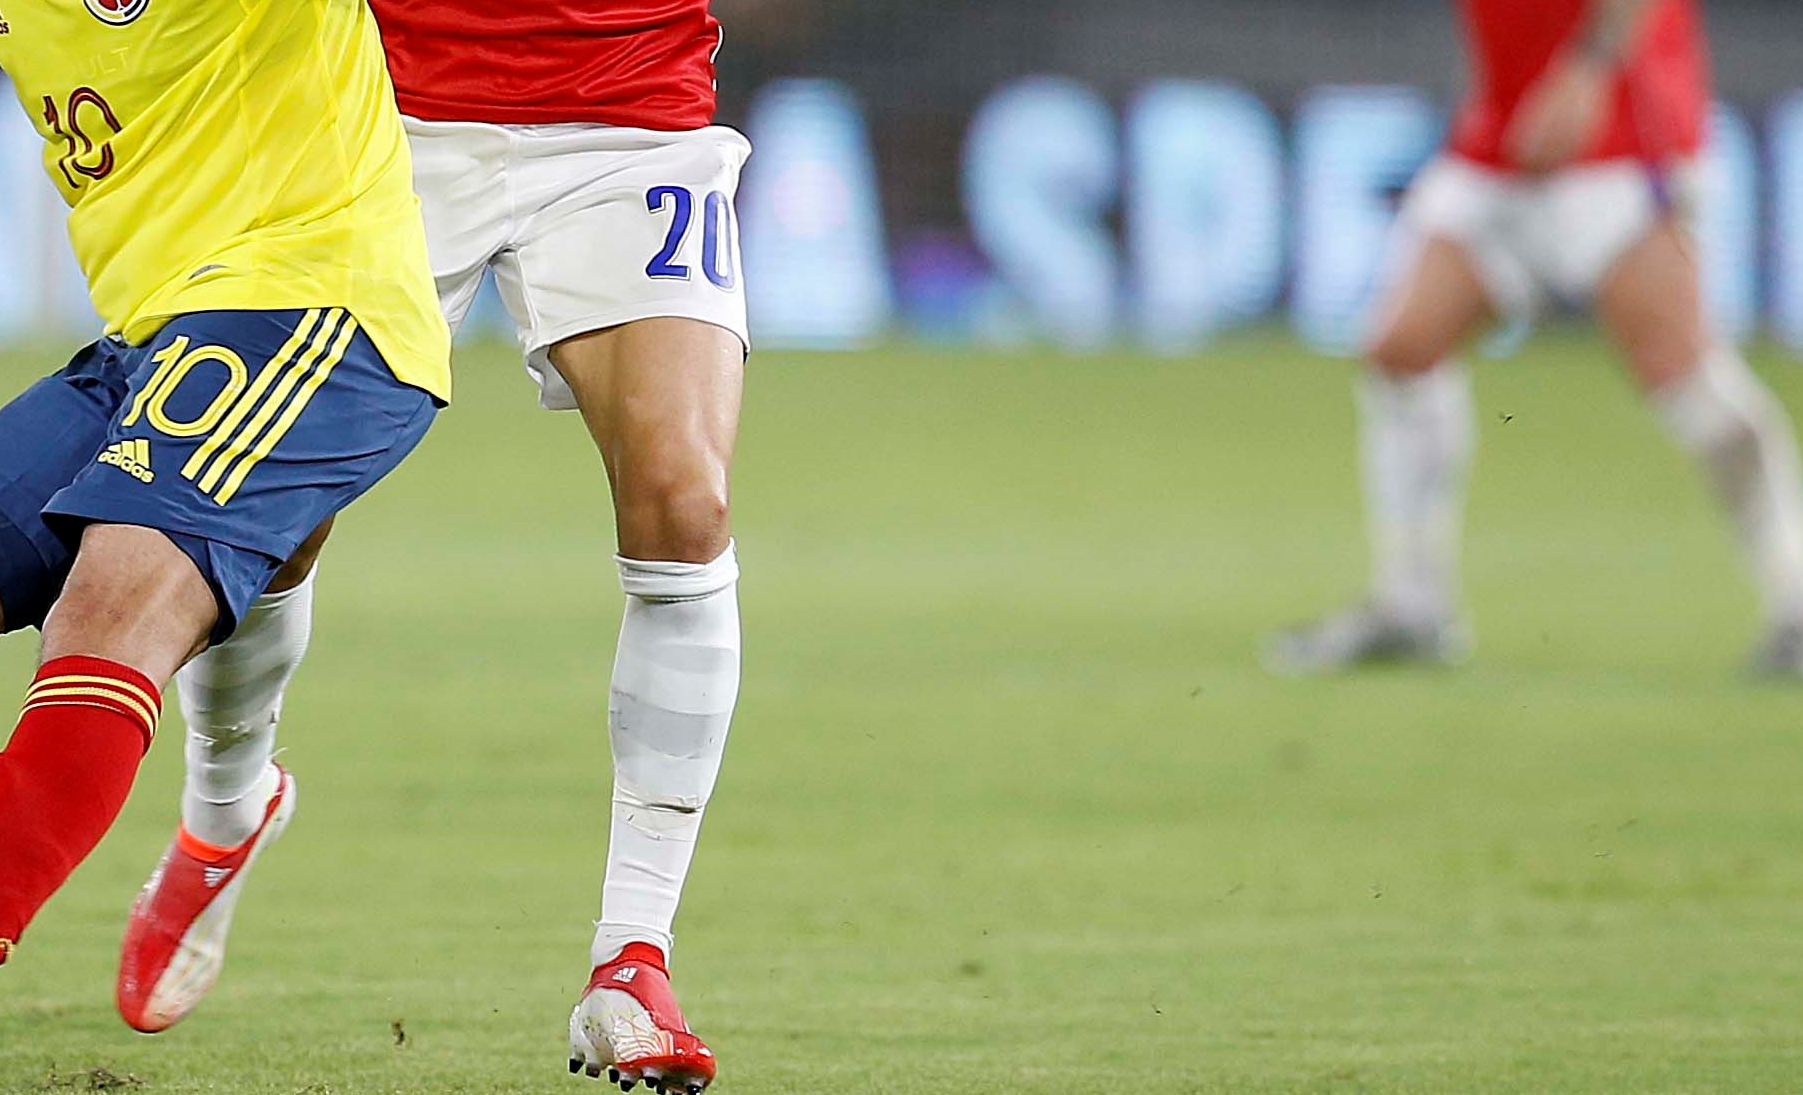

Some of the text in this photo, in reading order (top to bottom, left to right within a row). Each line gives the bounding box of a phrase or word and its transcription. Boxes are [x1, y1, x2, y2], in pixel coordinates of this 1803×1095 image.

[42, 86, 124, 189] 10
[645, 185, 737, 291] 20
[121, 335, 249, 437] 10
[97, 450, 155, 484] adidas
